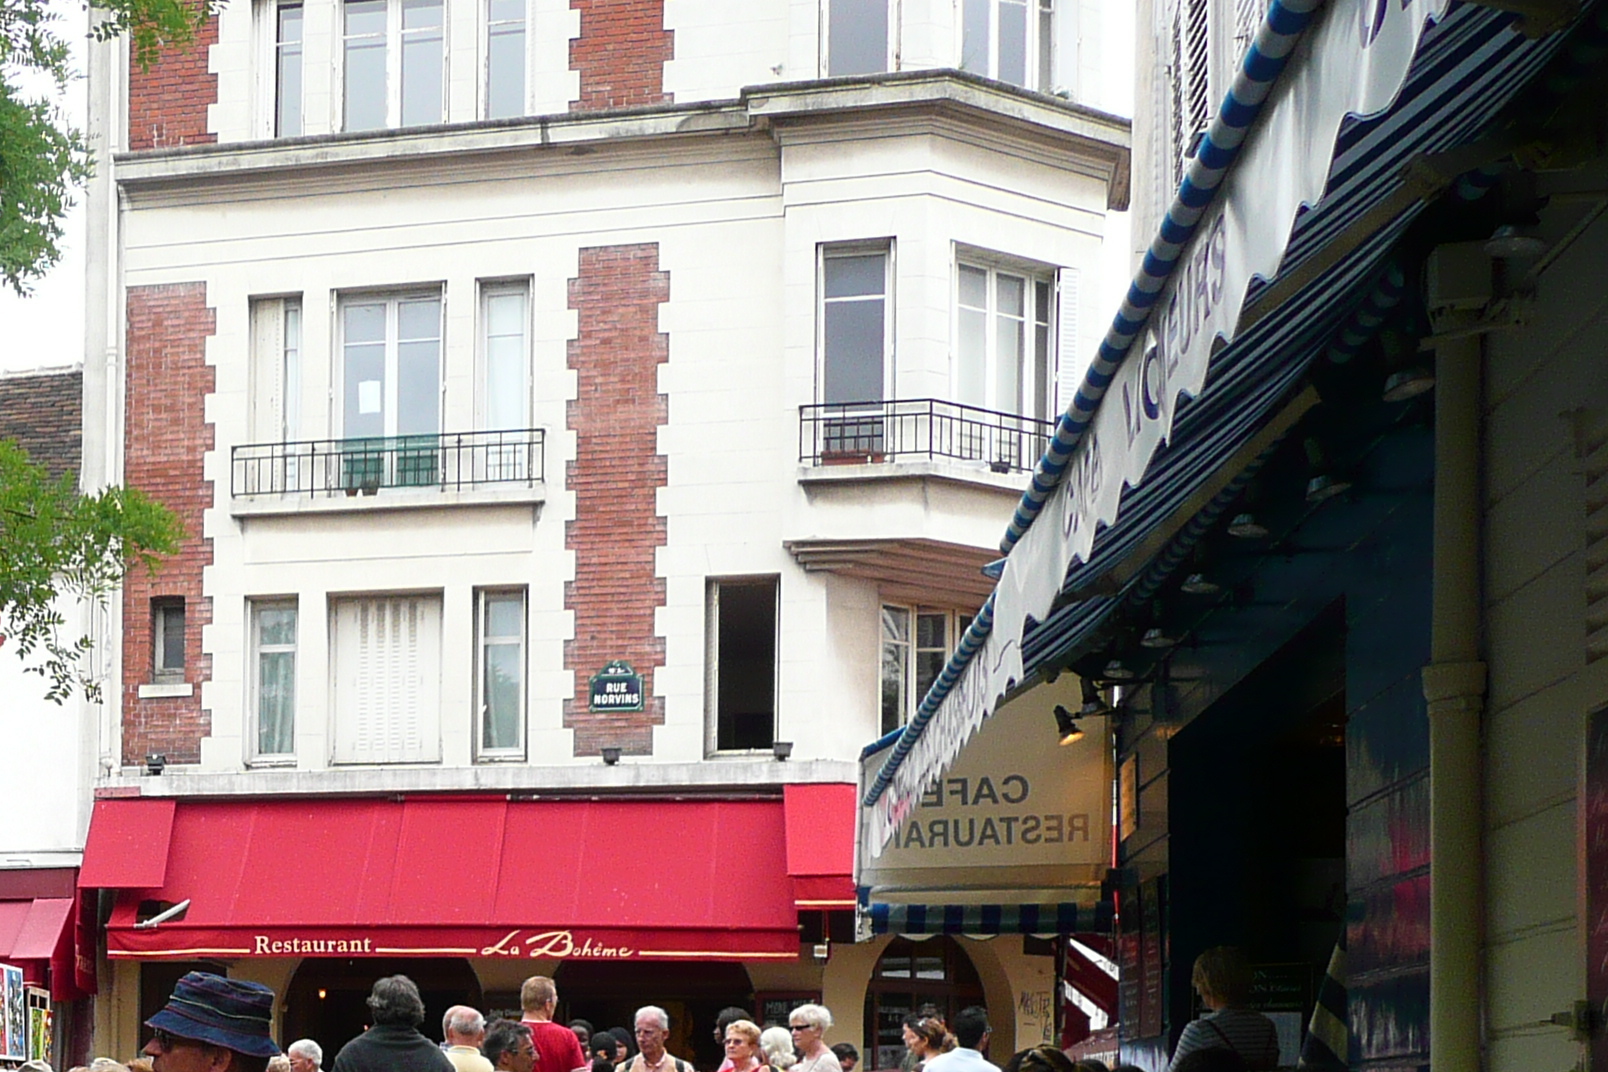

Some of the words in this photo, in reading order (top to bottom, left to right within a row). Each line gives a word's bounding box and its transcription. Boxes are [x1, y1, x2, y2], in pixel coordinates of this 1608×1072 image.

[606, 682, 628, 694] RUE
[593, 693, 639, 705] NORVINS
[254, 935, 372, 954] Restaurant
[481, 929, 521, 956] La
